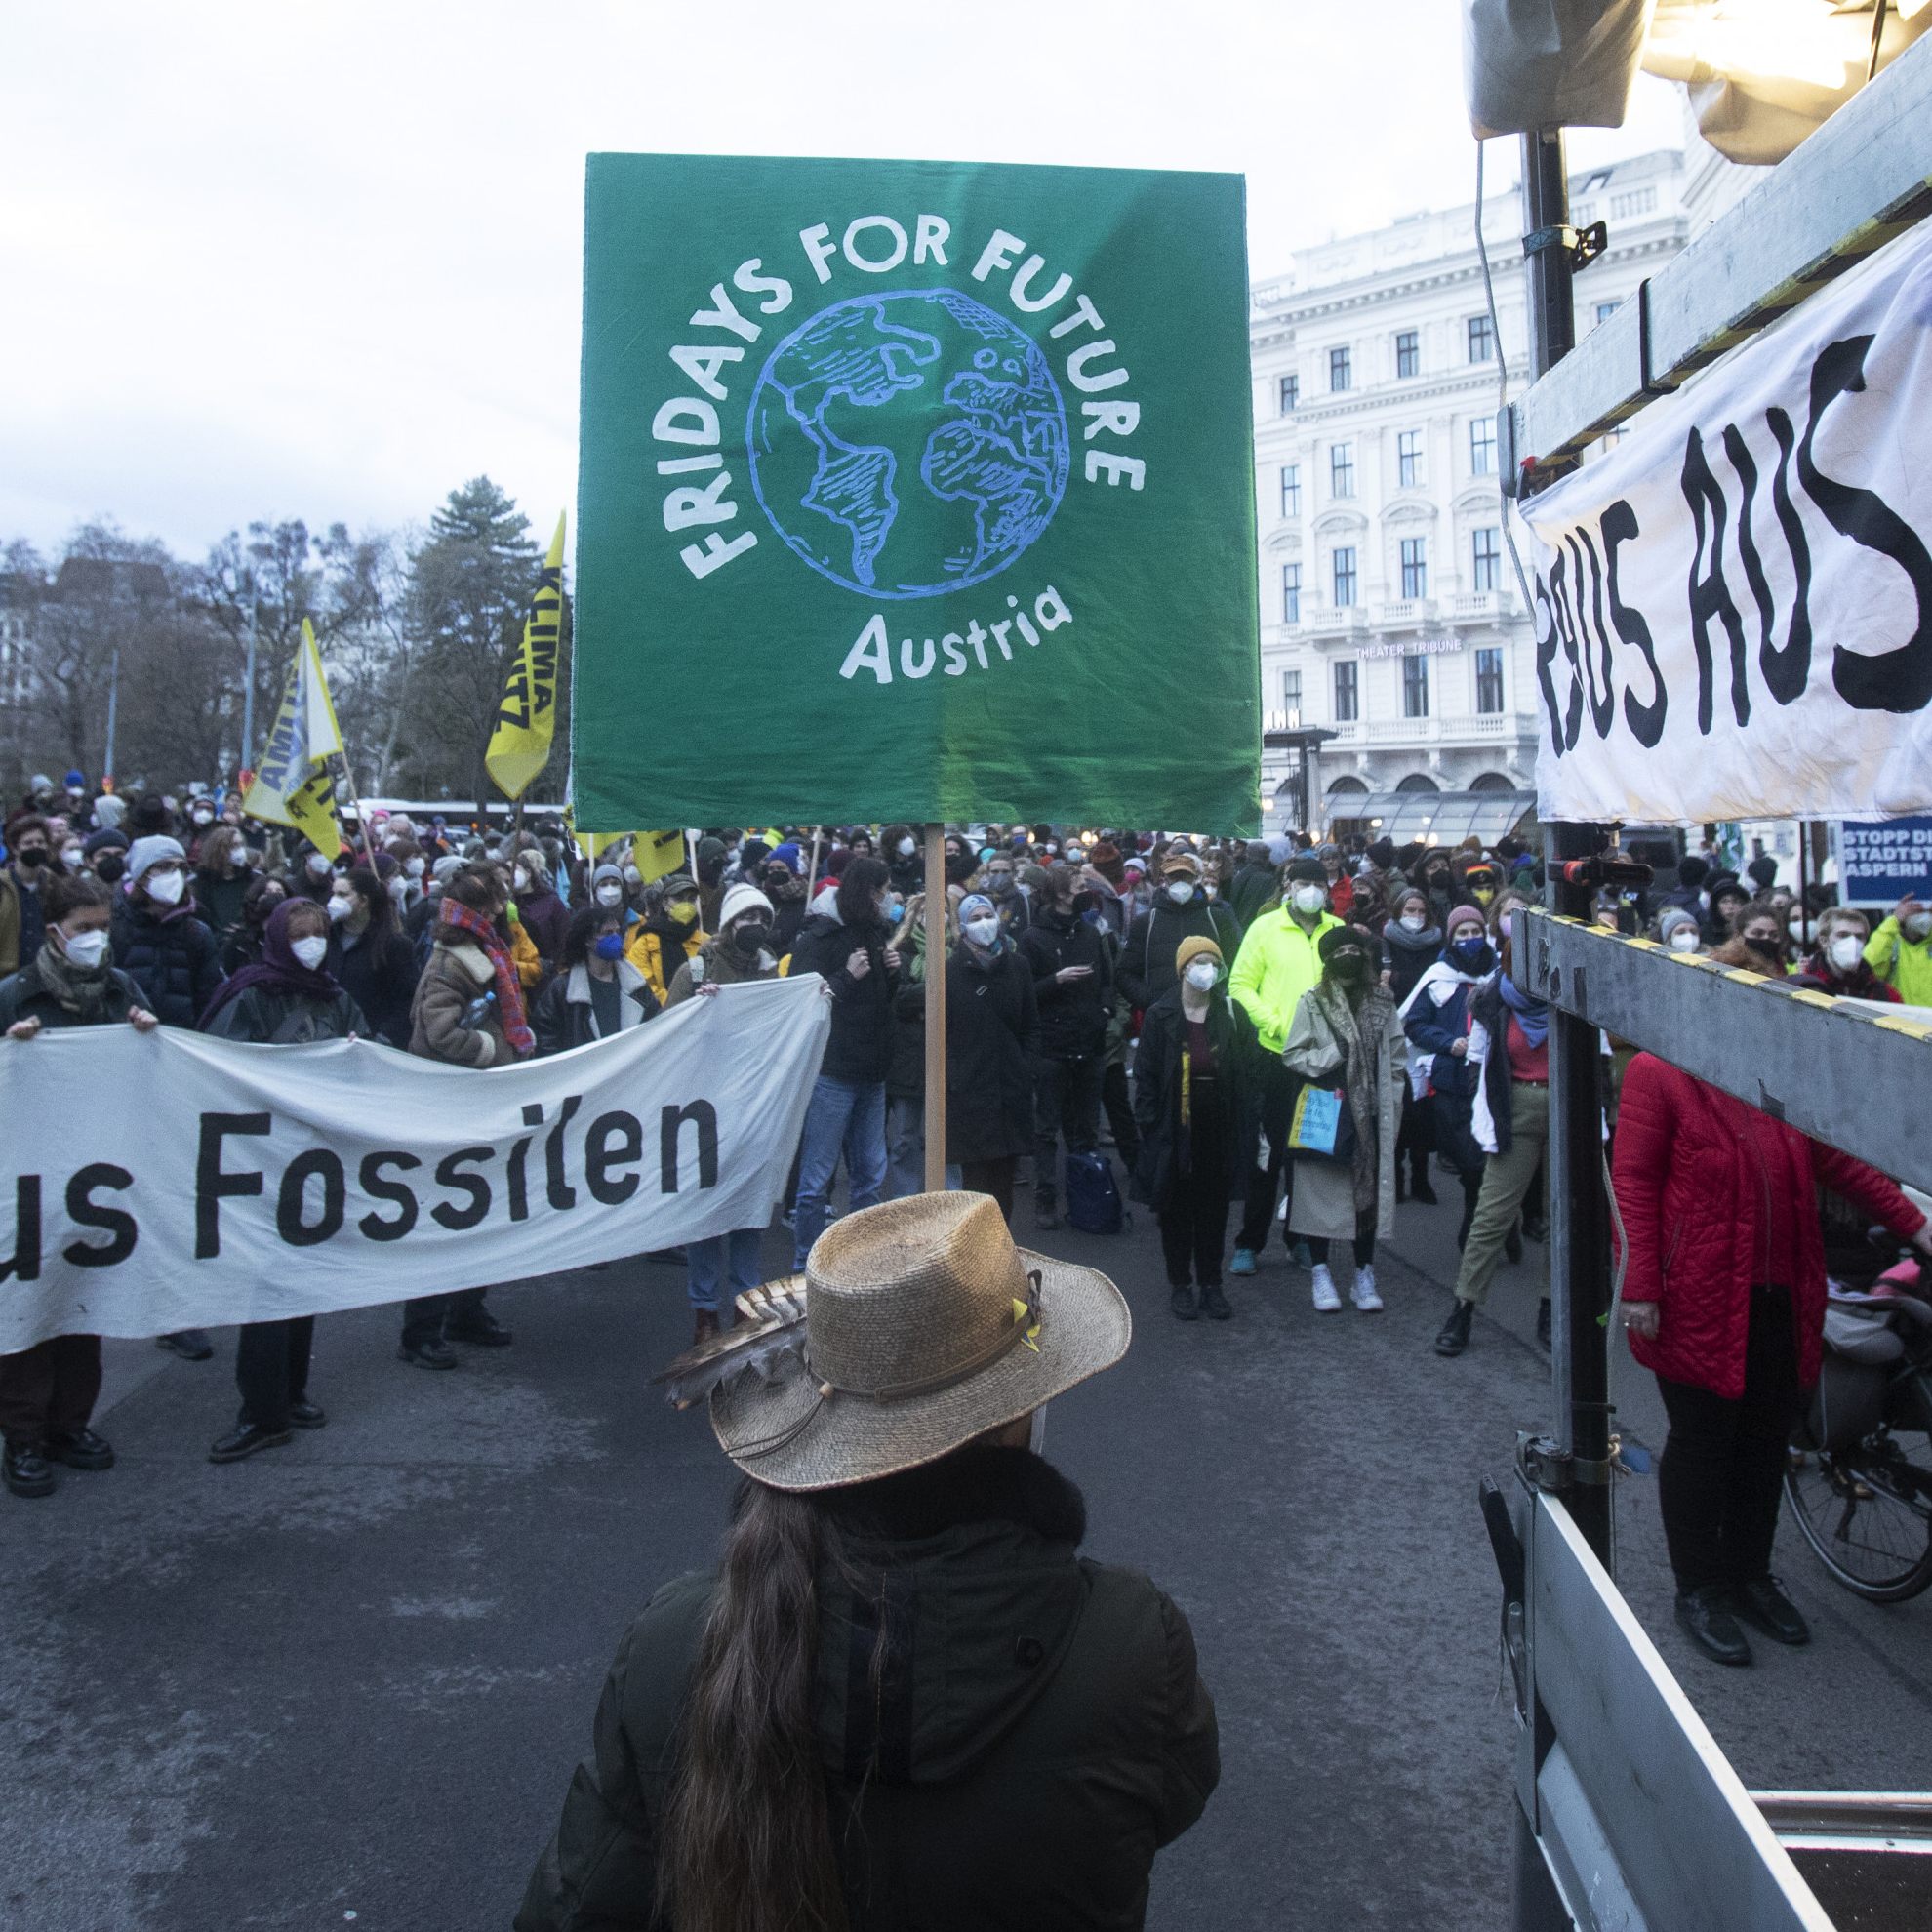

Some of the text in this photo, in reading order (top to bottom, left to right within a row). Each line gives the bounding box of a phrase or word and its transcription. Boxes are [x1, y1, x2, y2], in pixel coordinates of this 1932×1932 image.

[653, 215, 1147, 580] FRIDAYS FOR FUTURE
[1681, 333, 1932, 734] AUS
[528, 567, 561, 715] KLIMA
[839, 584, 1073, 685] Austria
[1355, 644, 1405, 659] THEATER
[1844, 831, 1910, 845] STOPP
[1847, 863, 1927, 877] ASPERN
[195, 1094, 719, 1260] Fossilen
